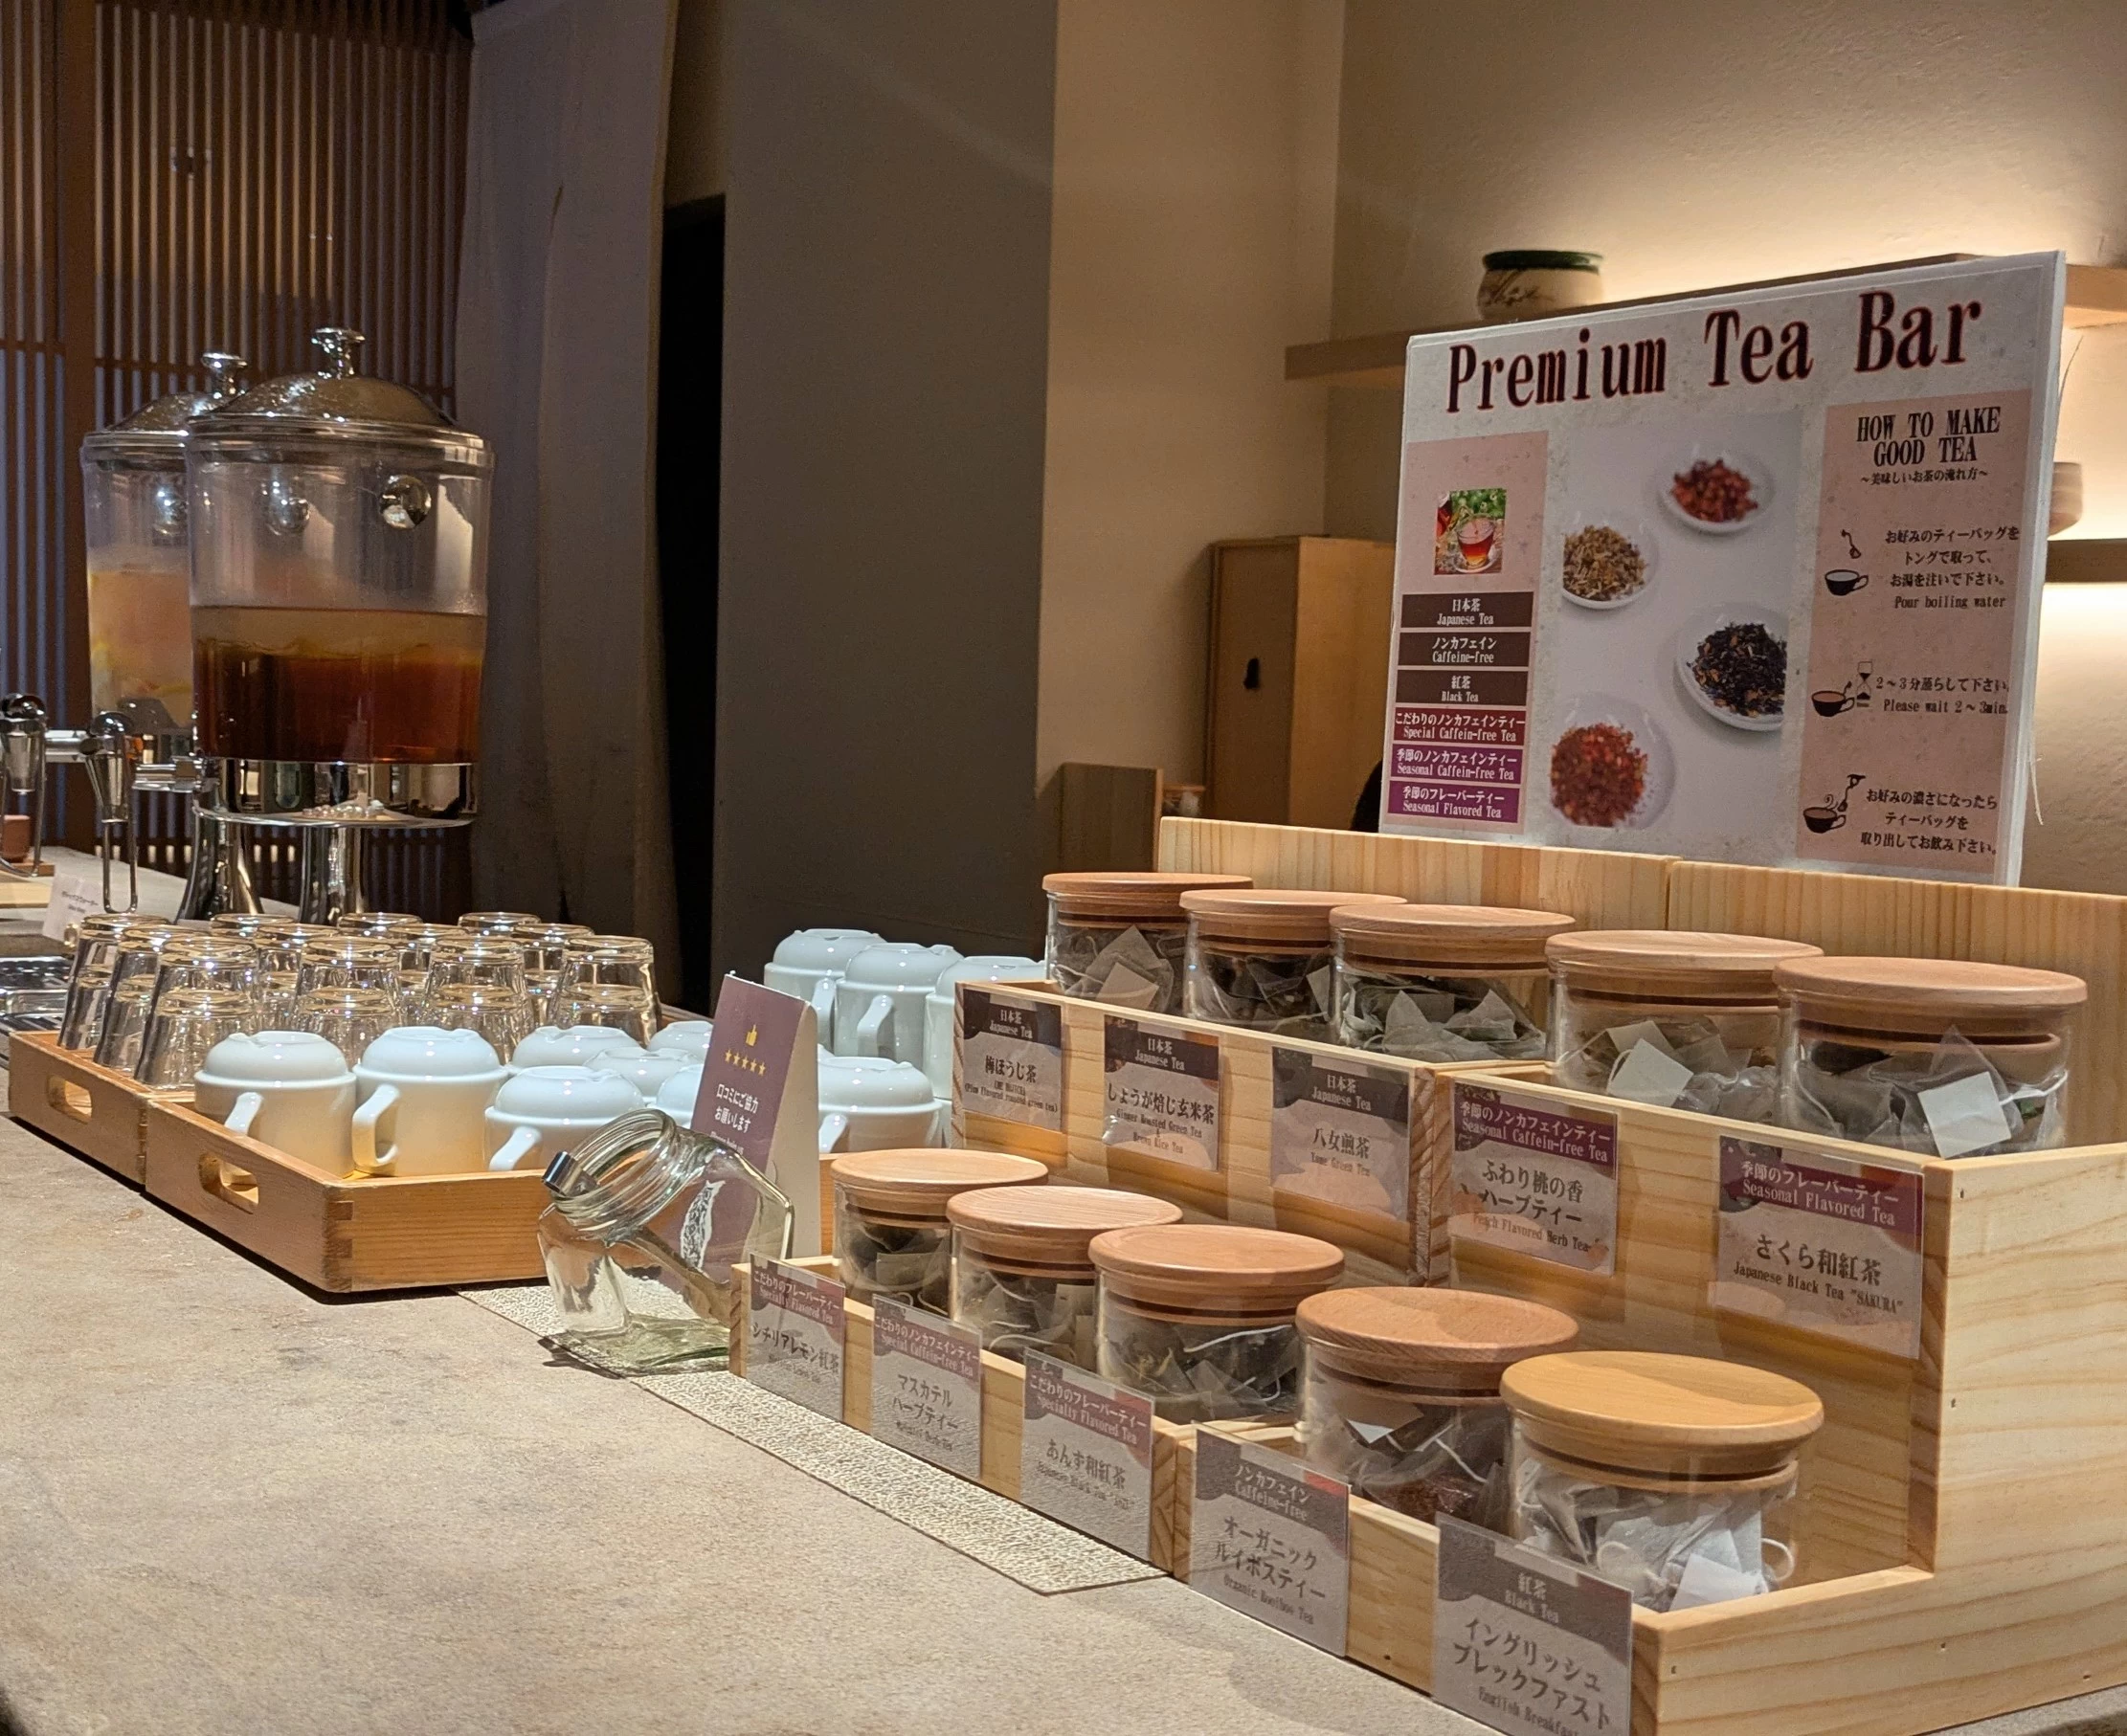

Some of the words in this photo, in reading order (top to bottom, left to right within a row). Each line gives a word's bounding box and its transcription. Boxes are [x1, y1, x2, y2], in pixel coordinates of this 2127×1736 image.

[1446, 328, 1668, 413] Premium
[1705, 309, 1812, 387] Tea
[1854, 291, 1981, 372] Bar
[1857, 414, 1895, 441] HOW
[1909, 412, 1934, 438] TO
[1946, 407, 2001, 435] MAKE
[1874, 439, 1925, 466] GOOD
[1938, 436, 1977, 462] TEA
[1885, 527, 2020, 544] お好みのティーバッグを
[1452, 598, 1481, 612] 日本茶
[1894, 595, 1919, 609] Pour
[1925, 596, 1967, 609] boiling
[1974, 596, 2006, 608] water
[1437, 613, 1475, 626] Japanese
[1479, 612, 1493, 625] Tea
[1432, 636, 1497, 650] ノンカフェイン
[1432, 651, 1494, 663] Caffeine-free
[1451, 676, 1471, 689] 紅茶
[1442, 691, 1463, 701] Black
[1467, 692, 1479, 702] Tea
[1884, 700, 1919, 712] Please
[1925, 701, 1948, 713] wait
[1396, 712, 1526, 727] こだわりのノンカフェインティー
[1403, 726, 1435, 739] Special
[1440, 727, 1497, 741] Caffein-free
[1501, 730, 1516, 742] Tea
[1397, 748, 1517, 766] 季節のノンカフェインティー
[1397, 763, 1433, 776] Seasonal
[1438, 764, 1495, 780] Caffein-free
[1499, 768, 1514, 780] Tea
[1402, 786, 1505, 804] 季節のフレーバーティー
[1867, 789, 1998, 810] お好みの濃さになったら
[1402, 800, 1439, 813] Seasonal
[1444, 802, 1482, 817] Flavored
[1487, 806, 1502, 818] Tea
[1885, 812, 1968, 830] ティーバッグを
[1020, 1025, 1033, 1038] Tea
[985, 1055, 1037, 1083] 梅ほうじ茶
[1135, 1050, 1168, 1068] Japanese
[1172, 1057, 1185, 1070] Tea
[1327, 1075, 1356, 1093] 日本茶
[1312, 1086, 1352, 1106] Japanese
[1355, 1096, 1371, 1111] Tea
[715, 1105, 751, 1133] お願いします
[1460, 1102, 1611, 1144] 季節のノンカフェインティー
[1312, 1127, 1370, 1159] 八女煎茶
[1463, 1119, 1507, 1141] Seasonal
[1512, 1129, 1584, 1157] Caffein-free
[1588, 1145, 1607, 1163] Tea
[1483, 1159, 1583, 1204] ふわり桃の香
[1742, 1161, 1899, 1204] 季節のフレーバーティー
[1743, 1179, 1799, 1206] Seasonal
[1805, 1192, 1865, 1220] Flavored
[1872, 1208, 1895, 1226] Tea
[1502, 1218, 1543, 1240] Flavored
[1547, 1231, 1568, 1248] Herb
[1573, 1236, 1590, 1253] Tea
[1757, 1234, 1881, 1286] さくら和紅茶
[1734, 1261, 1781, 1285] Japanese
[1787, 1274, 1819, 1294] Black
[1825, 1283, 1845, 1301] Tea
[897, 1373, 953, 1408] マスカテル
[1081, 1410, 1119, 1436] Flavored
[1121, 1427, 1137, 1445] Tea
[1046, 1438, 1126, 1490] あんず和紅茶
[1235, 1465, 1311, 1503] ノンカフェイン
[1224, 1516, 1317, 1570] オーガニック
[1214, 1541, 1326, 1598] ルイボスティー
[1466, 1617, 1601, 1692] イングリッシュ
